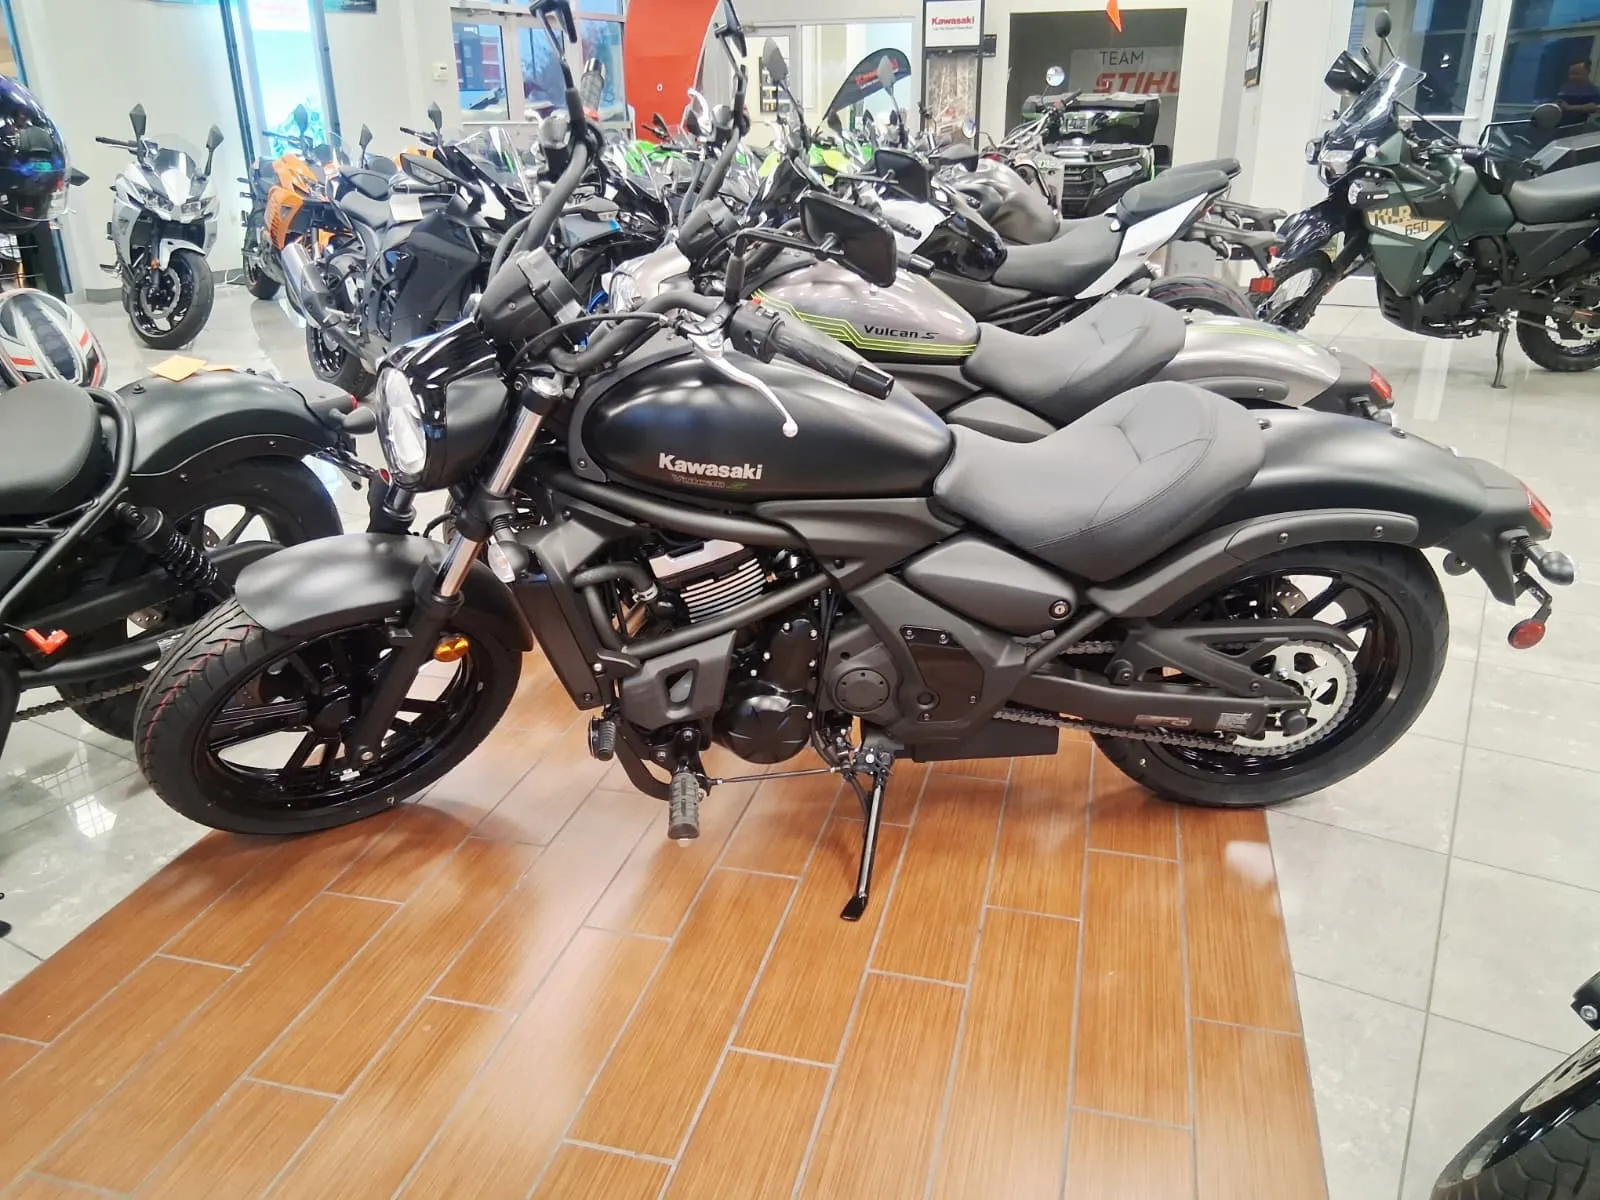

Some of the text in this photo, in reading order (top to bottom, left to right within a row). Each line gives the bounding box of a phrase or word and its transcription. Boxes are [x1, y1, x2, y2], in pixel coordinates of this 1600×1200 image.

[931, 16, 975, 26] Kawasaki
[1099, 50, 1145, 66] TEAM
[1093, 71, 1180, 94] STIHL
[1405, 220, 1429, 236] 650
[864, 324, 918, 338] Vulcan
[658, 453, 763, 480] Kawasaki
